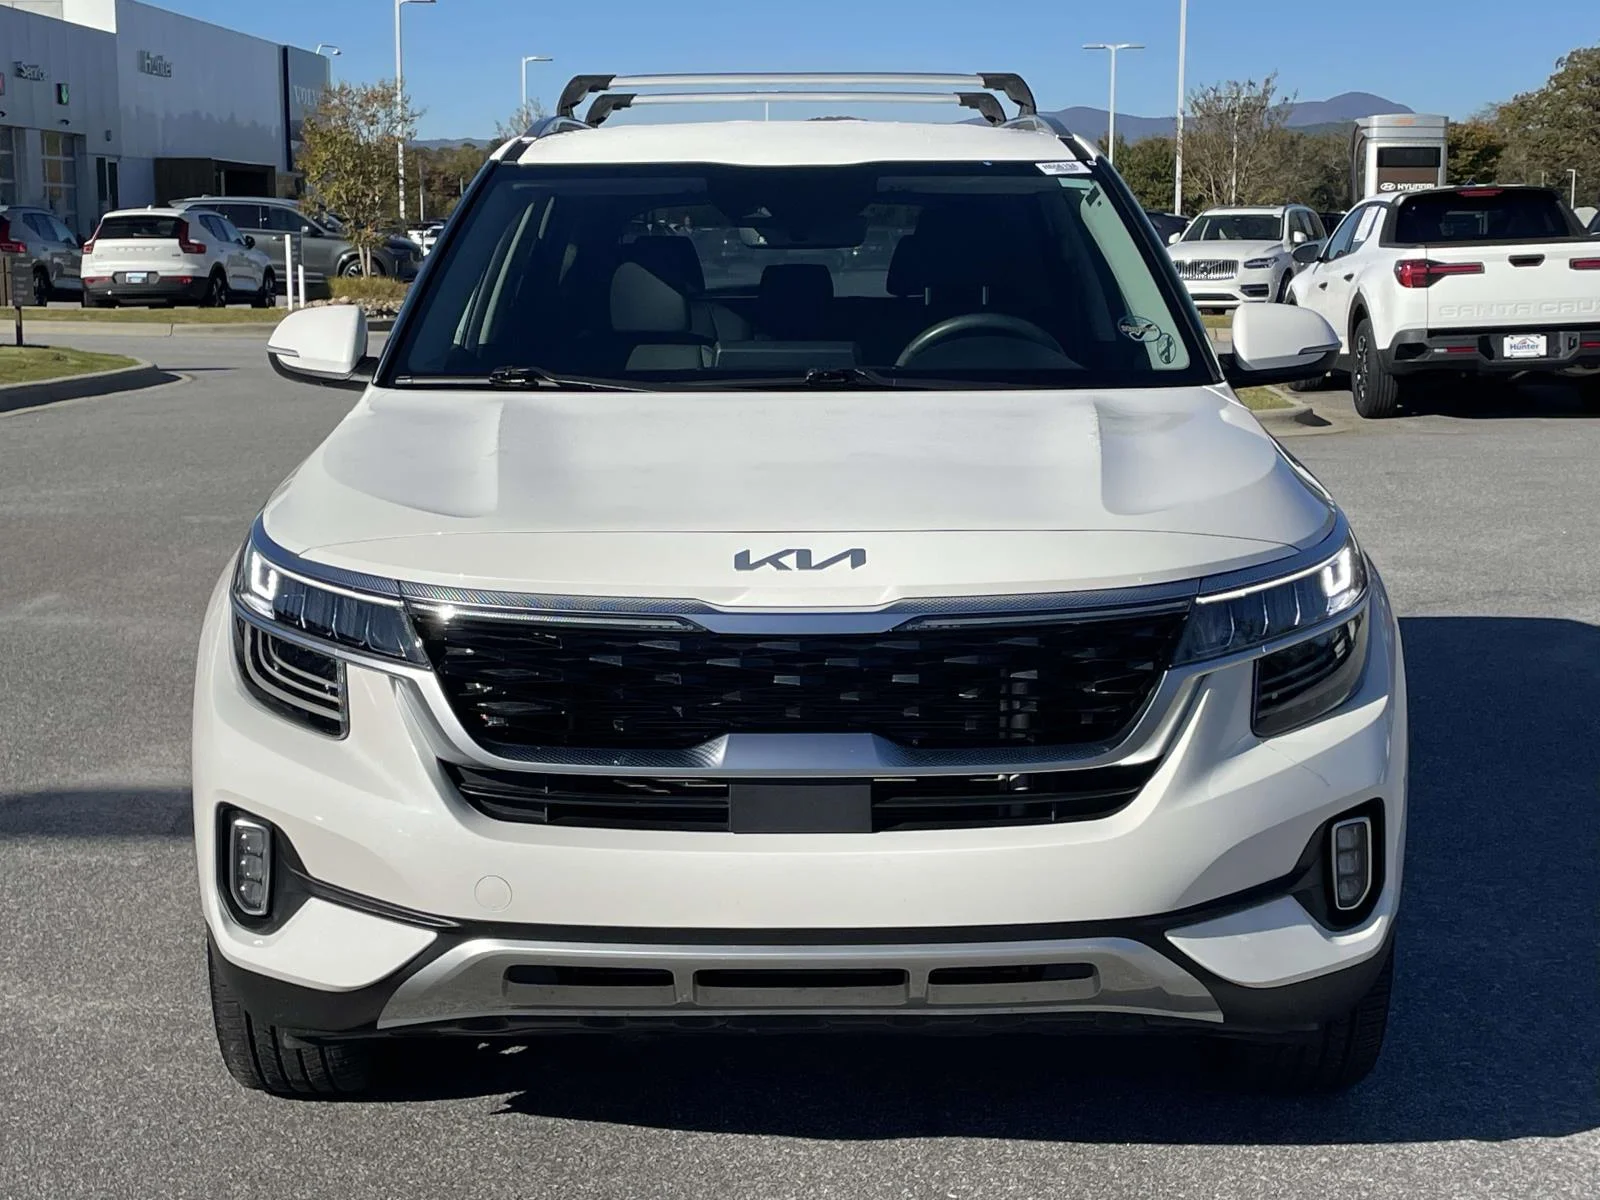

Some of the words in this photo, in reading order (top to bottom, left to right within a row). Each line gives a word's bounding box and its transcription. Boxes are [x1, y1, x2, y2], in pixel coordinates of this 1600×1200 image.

[1439, 302, 1533, 318] SANTA
[1539, 299, 1600, 315] CRU
[734, 549, 866, 570] KIA
